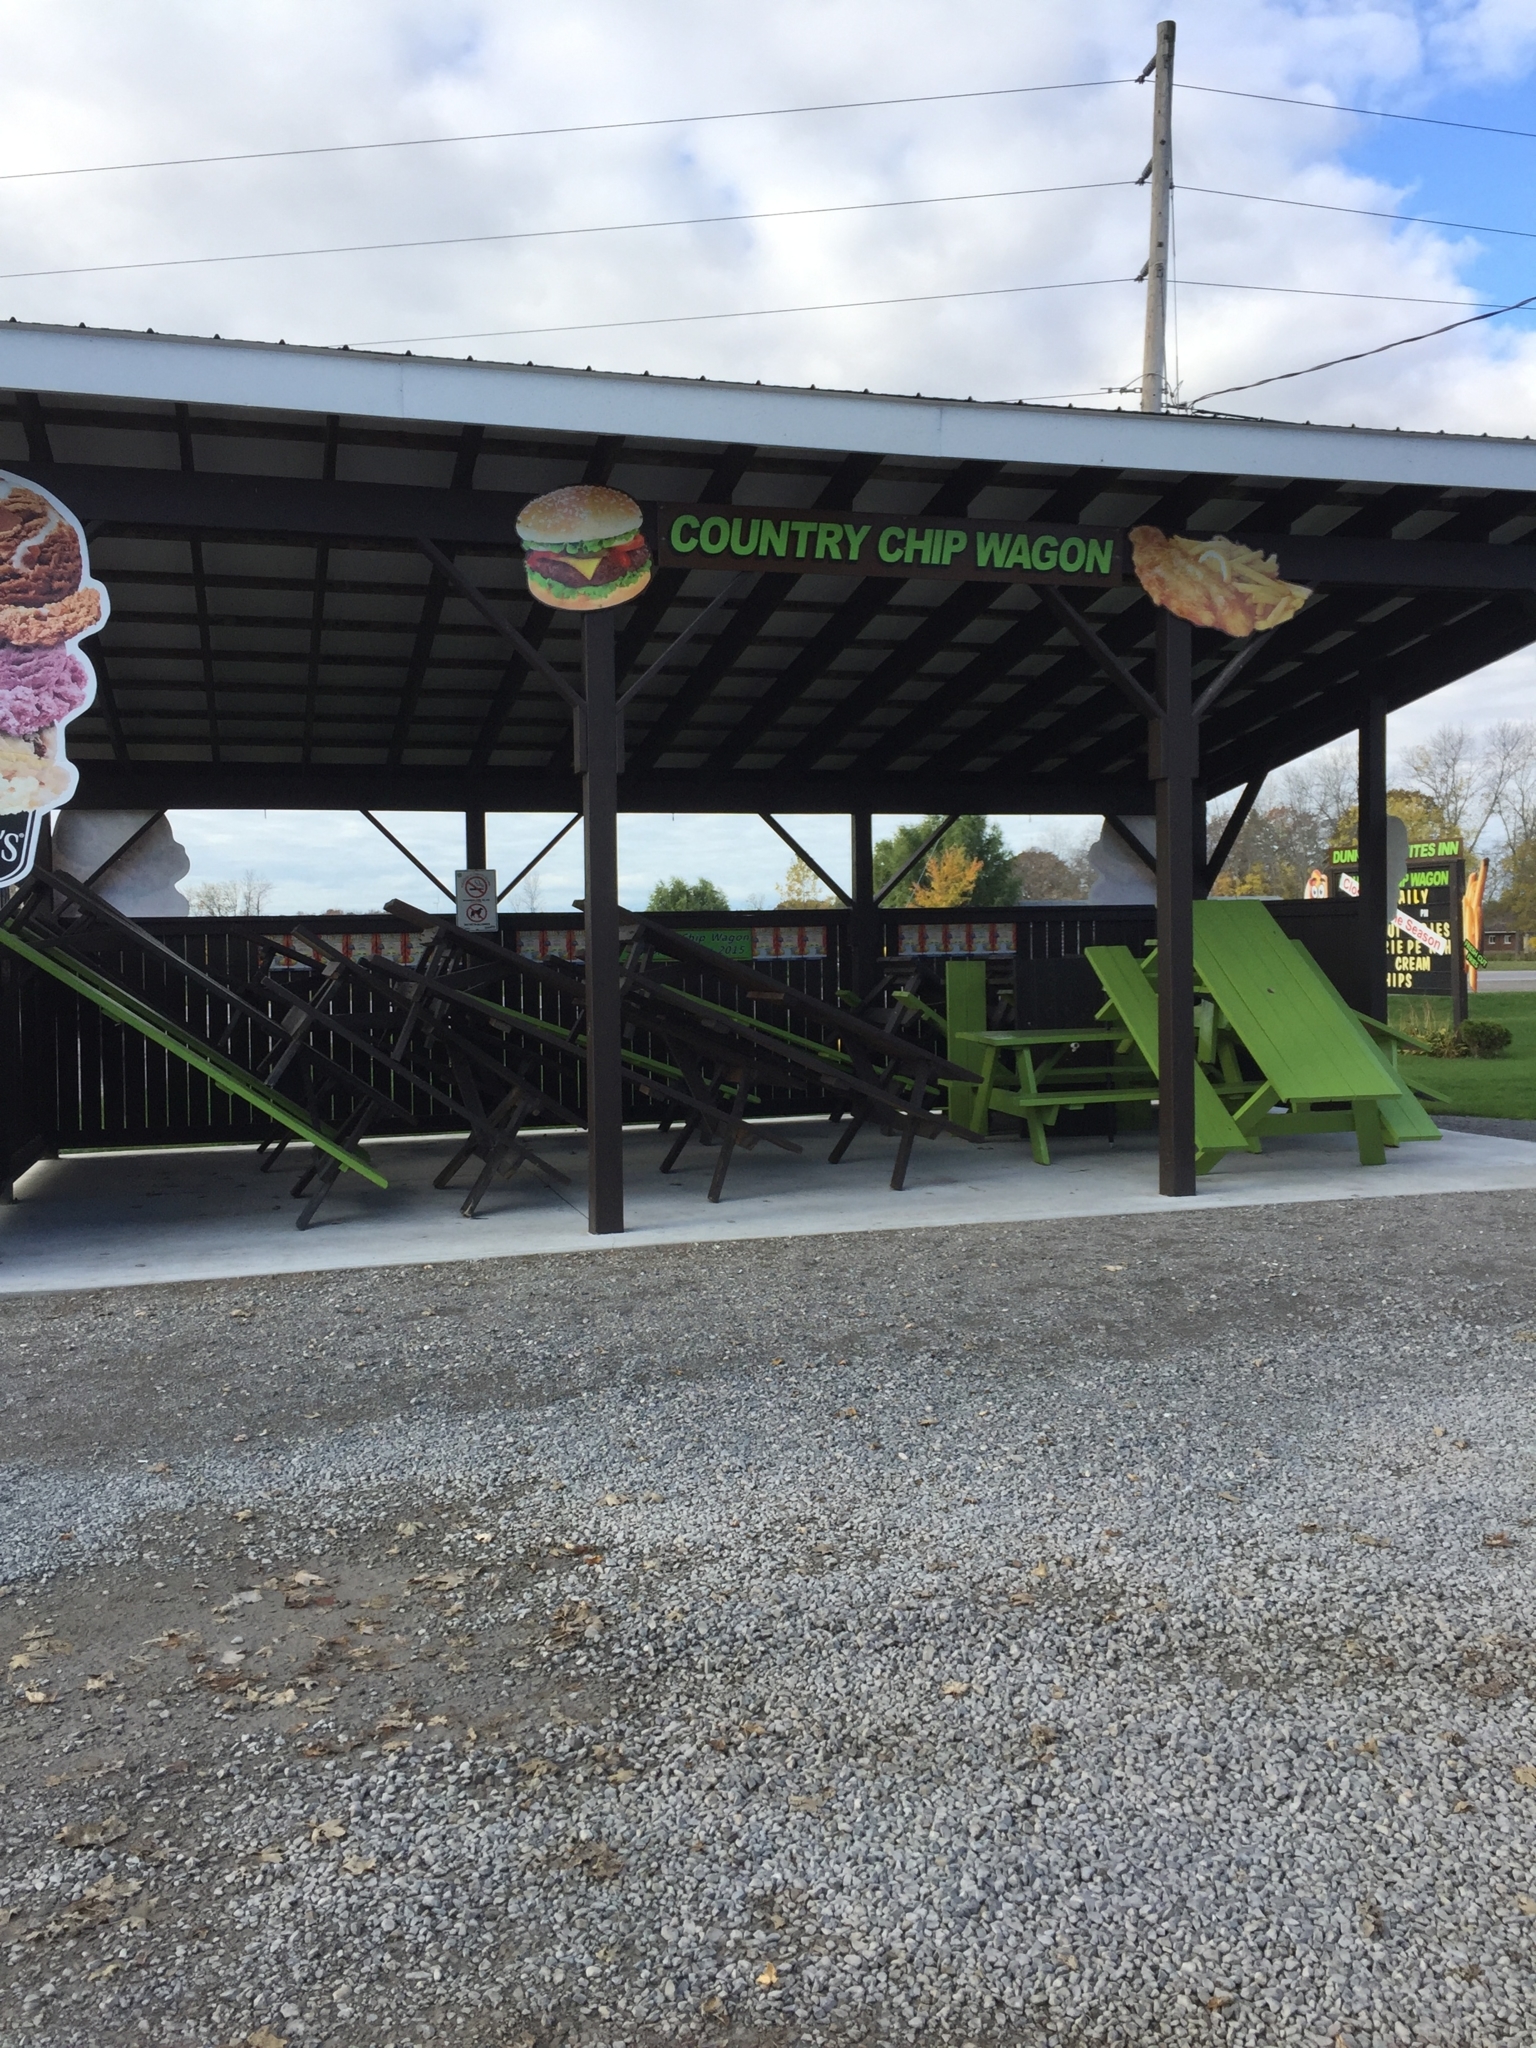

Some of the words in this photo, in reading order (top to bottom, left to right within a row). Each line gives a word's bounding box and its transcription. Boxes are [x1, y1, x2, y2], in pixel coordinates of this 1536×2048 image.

[670, 514, 871, 562] COUNTRY
[878, 526, 968, 566] CHIP
[976, 531, 1114, 574] WAGON
[1438, 840, 1460, 857] INN
[1410, 871, 1450, 887] WAGON
[1405, 918, 1442, 951] Season
[1395, 956, 1431, 971] CREAM
